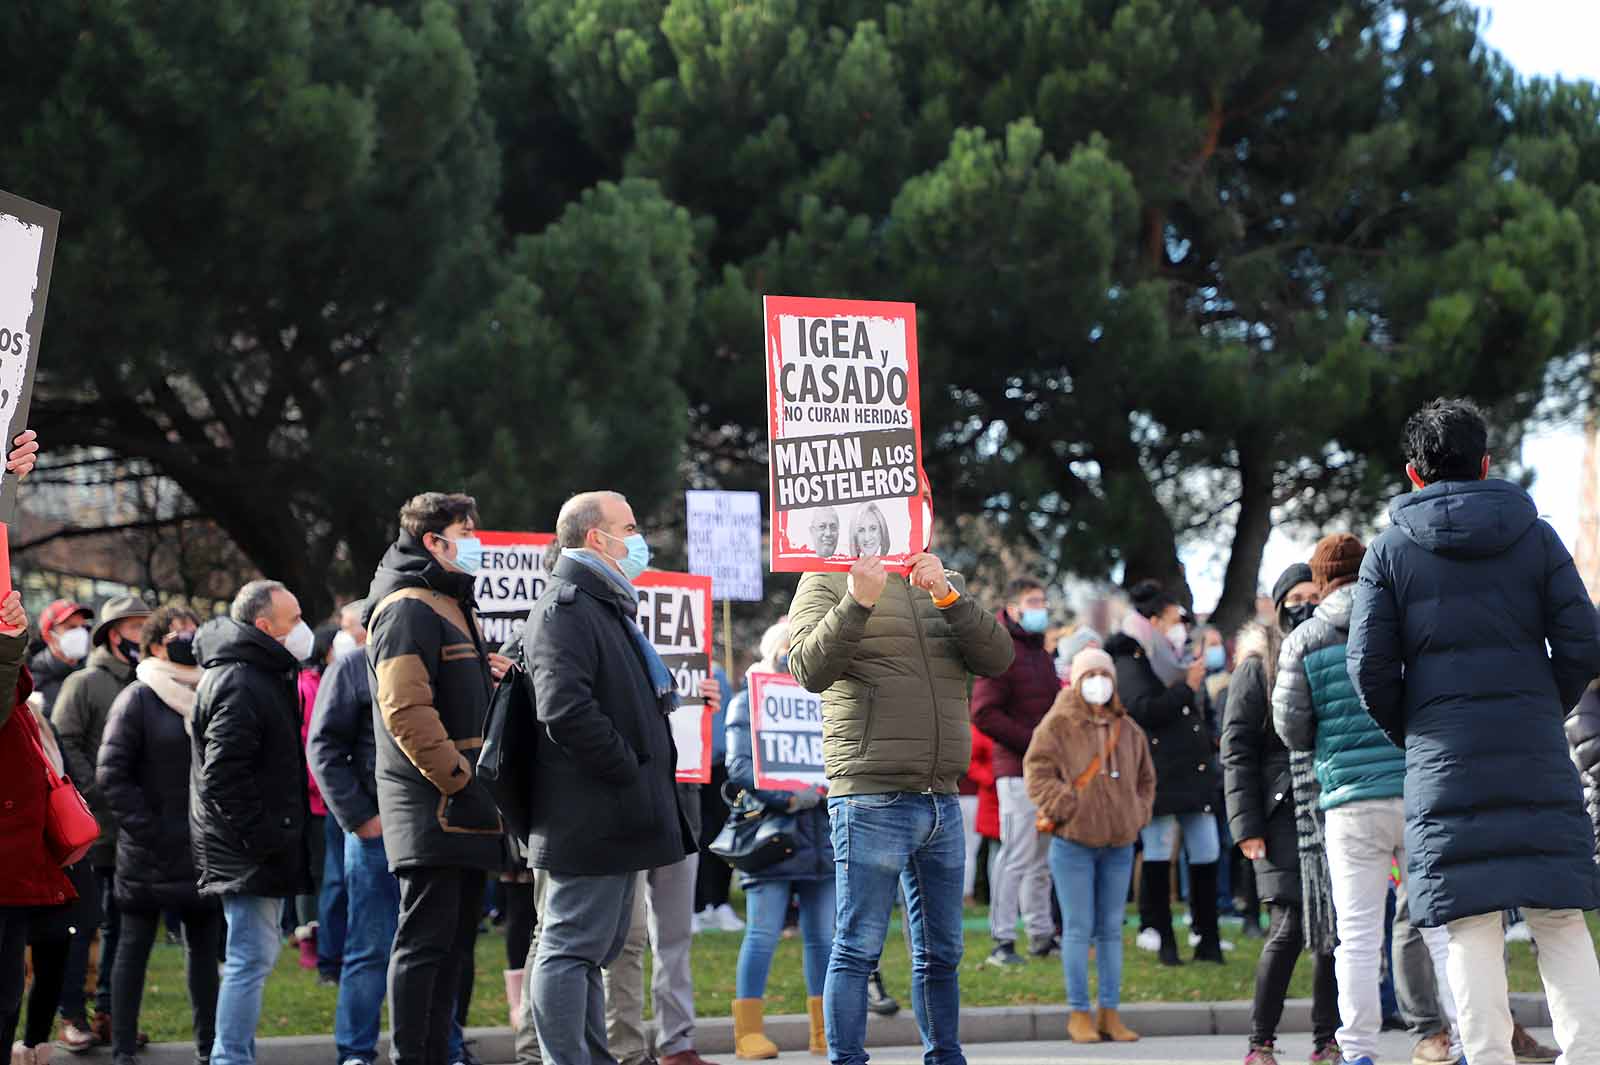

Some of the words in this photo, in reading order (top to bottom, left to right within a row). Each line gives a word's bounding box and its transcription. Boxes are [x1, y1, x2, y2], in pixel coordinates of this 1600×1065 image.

[0, 327, 23, 356] OS
[798, 318, 873, 360] IGEA
[780, 362, 909, 406] CASADO
[785, 406, 803, 422] NO
[807, 406, 850, 423] CURAN
[854, 408, 908, 425] HERIDAS
[775, 437, 863, 476] MATAN
[871, 447, 883, 467] A
[885, 444, 914, 465] LOS
[778, 466, 917, 506] HOSTELEROS
[481, 546, 545, 571] ERÓNI
[477, 576, 546, 601] ASAD
[636, 590, 697, 647] GEA
[766, 695, 823, 723] QUER
[761, 732, 825, 766] TRAB
